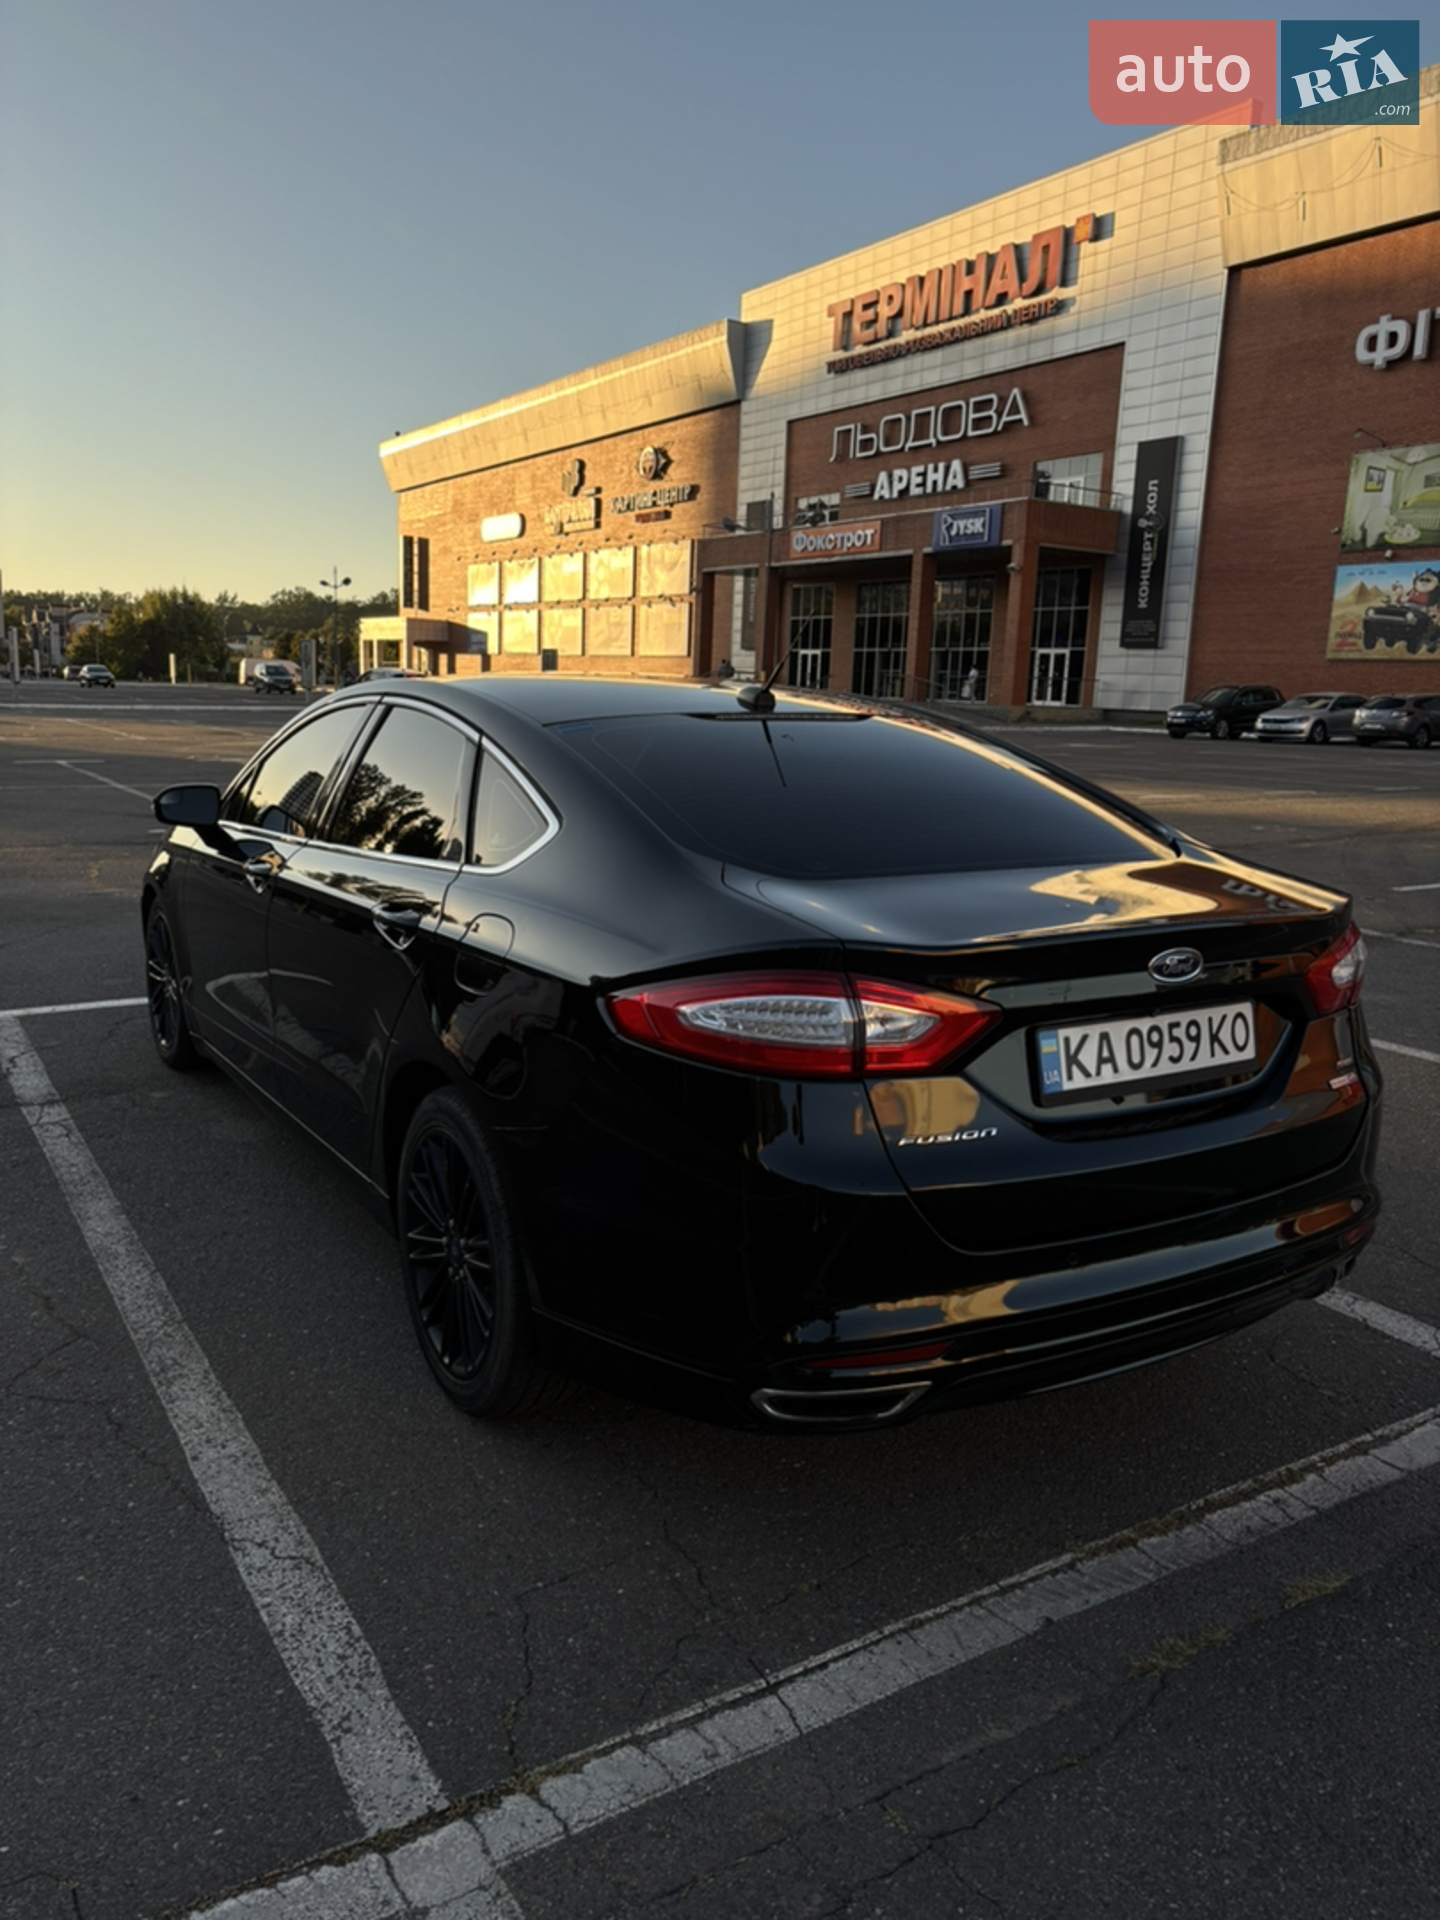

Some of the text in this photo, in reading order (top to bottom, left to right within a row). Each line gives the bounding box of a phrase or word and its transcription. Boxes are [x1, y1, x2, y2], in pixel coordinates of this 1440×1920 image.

[827, 225, 1067, 352] ТЕРМІНАЛ
[1010, 297, 1060, 328] ЦЕНТР
[829, 387, 1030, 463] ЛЬОДОВА
[873, 458, 967, 501] АРЕНА
[949, 516, 986, 537] JYSK
[1137, 531, 1154, 609] КОНЦЕРТ
[1146, 479, 1160, 516] ХОЛ
[1063, 1011, 1250, 1081] KA 0959 KO
[1044, 1070, 1060, 1085] UA
